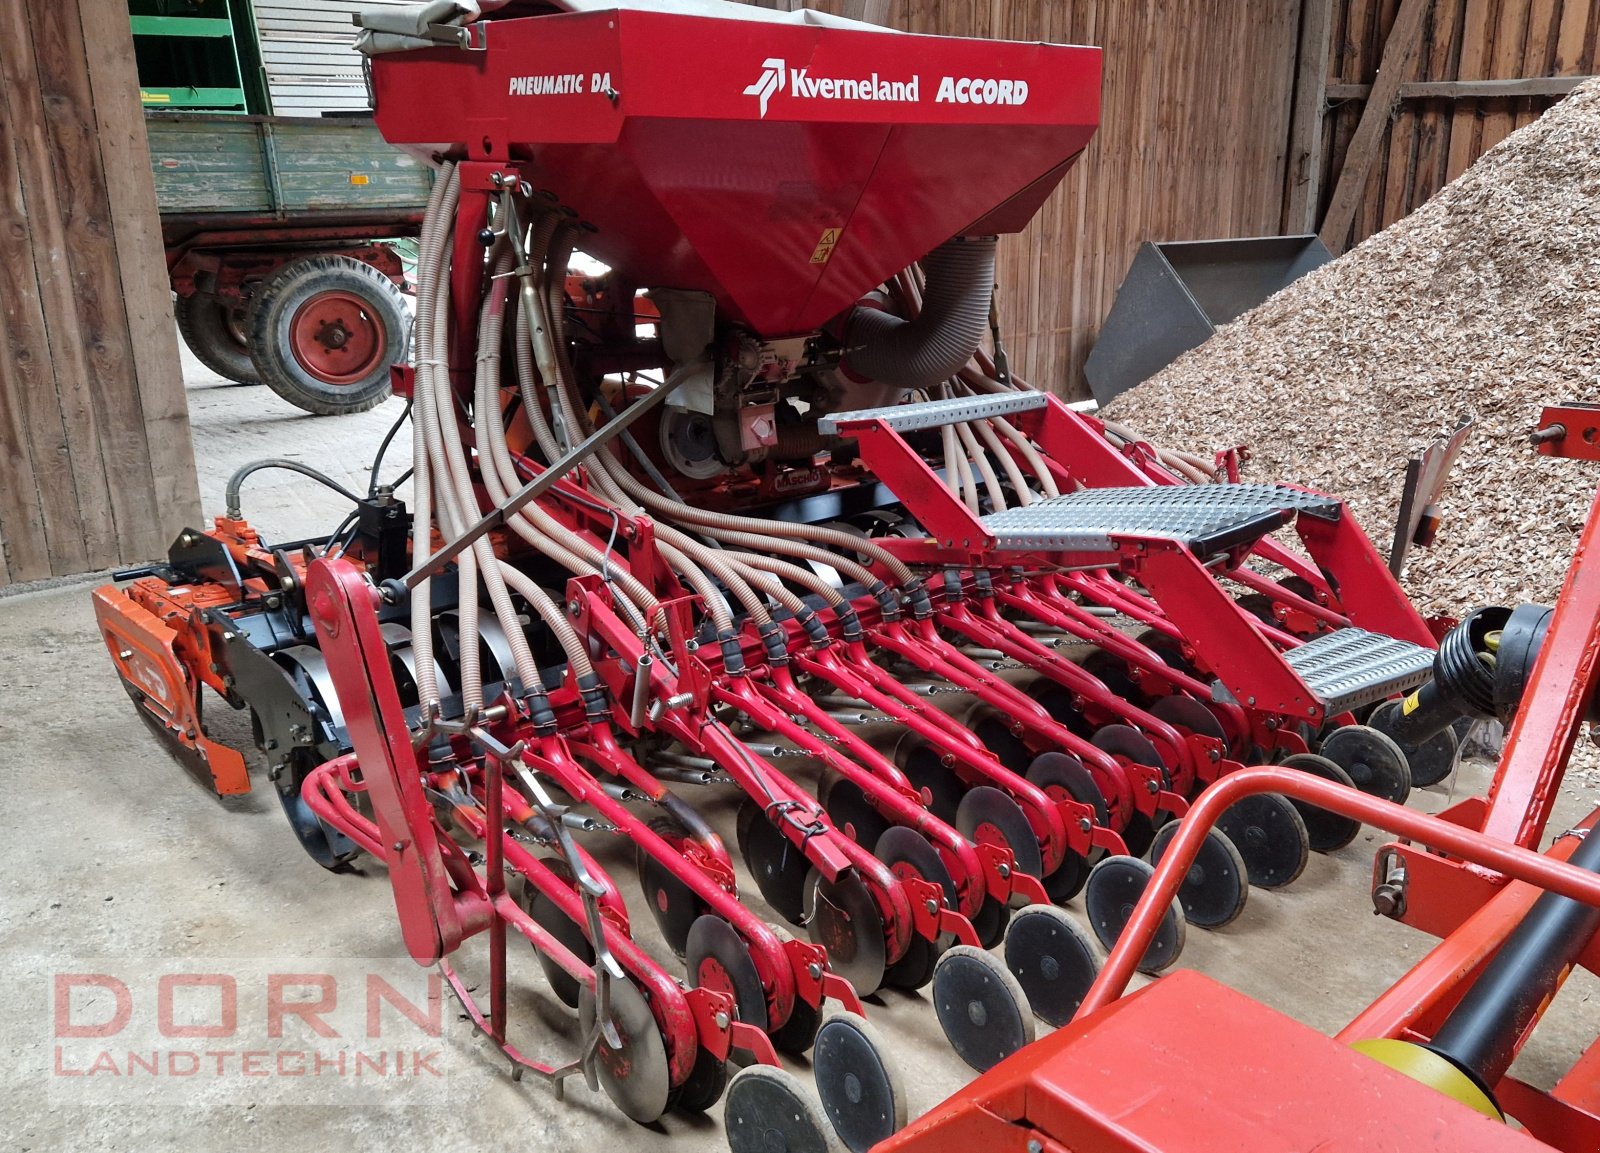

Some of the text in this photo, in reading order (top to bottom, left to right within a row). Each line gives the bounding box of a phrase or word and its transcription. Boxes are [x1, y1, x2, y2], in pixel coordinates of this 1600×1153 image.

[508, 72, 611, 96] PNEUMATIC DA
[791, 69, 1029, 106] Kverneland ACCORD
[776, 470, 819, 488] MASCHIO
